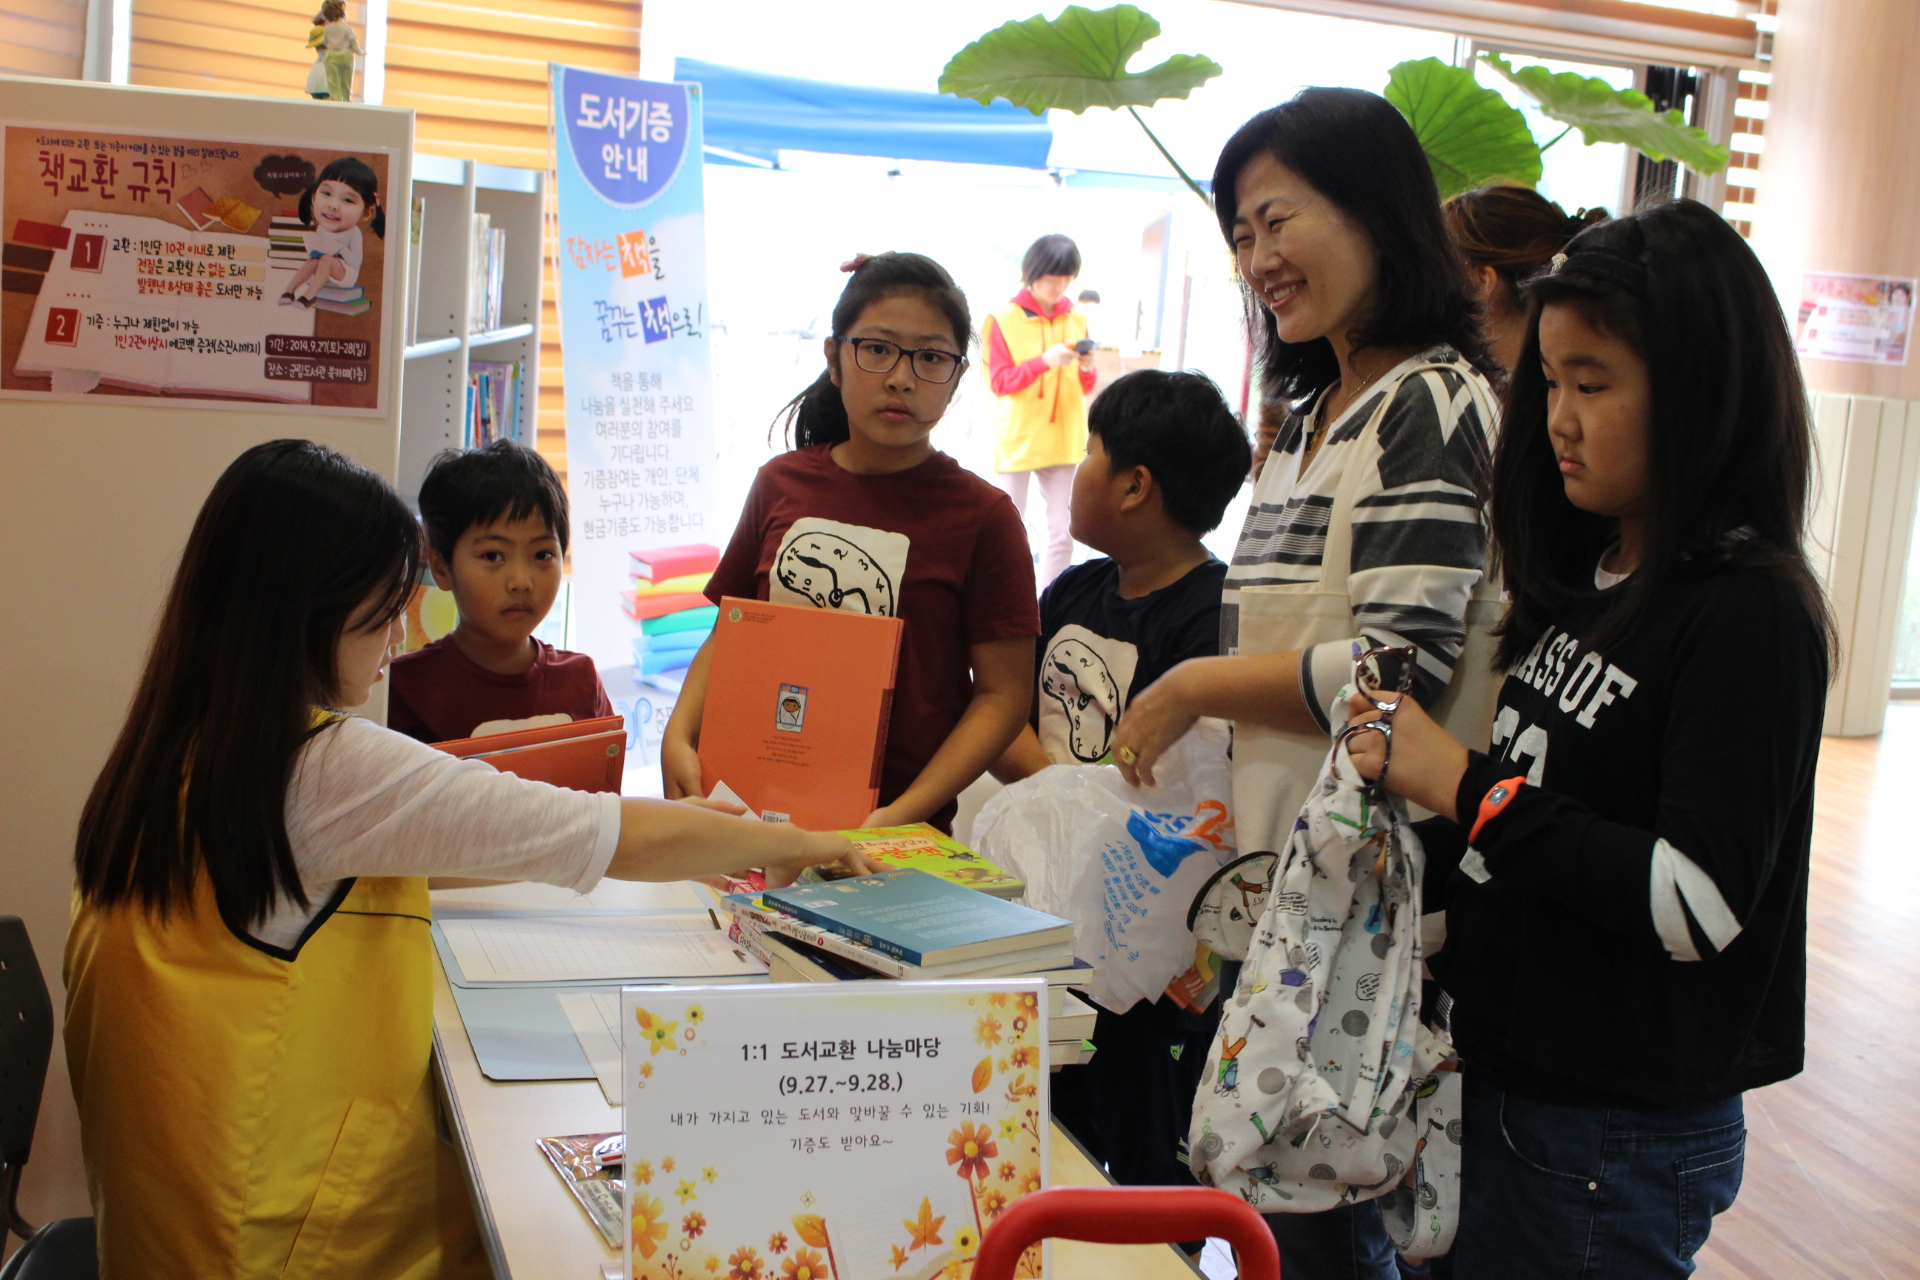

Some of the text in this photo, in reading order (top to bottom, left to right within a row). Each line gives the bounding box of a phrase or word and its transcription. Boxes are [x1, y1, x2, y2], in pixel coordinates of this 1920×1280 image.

[576, 92, 674, 144] 도서기증
[77, 140, 89, 150] 교환
[94, 141, 106, 150] 또는
[150, 145, 157, 154] 수
[158, 145, 170, 156] 있는
[602, 144, 648, 182] 안내
[38, 150, 175, 204] 책교환 규칙
[84, 242, 92, 264] 1
[112, 237, 131, 253] 교환
[140, 240, 162, 255] 1인당
[166, 242, 185, 256] 10권
[188, 244, 214, 256] 이내로
[218, 245, 235, 259] 제한
[167, 259, 193, 276] 교환할
[197, 261, 205, 276] 수
[208, 262, 225, 278] 없는
[229, 264, 246, 277] 도서
[138, 278, 165, 294] 발행년
[196, 281, 213, 297] 좋은
[216, 283, 242, 298] 도서만
[246, 286, 262, 300] 가능
[56, 315, 65, 335] 2
[87, 314, 104, 329] 기증
[113, 316, 140, 329] 누구나
[182, 321, 199, 334] 가능
[594, 297, 702, 342] 꿈꾸는 책으로!
[269, 339, 284, 351] 기간
[268, 363, 283, 376] 장소
[611, 372, 662, 392] 책을 통해
[581, 396, 615, 416] 나눔을
[620, 396, 655, 416] 실천해
[596, 419, 682, 440] 여러분의 참여를
[583, 470, 641, 490] 기증참여는
[676, 466, 699, 484] 단체
[599, 493, 633, 512] 누구나
[583, 517, 641, 539] 현금기증도
[833, 548, 848, 560] 2
[858, 559, 868, 571] 3
[875, 577, 885, 593] 4
[815, 592, 826, 607] 9
[1079, 657, 1094, 668] 2
[1099, 671, 1106, 683] 3
[1507, 624, 1638, 730] ASS OF
[1067, 697, 1075, 710] 9
[1107, 688, 1114, 703] 4
[1074, 715, 1081, 731] 8
[1075, 737, 1083, 753] 7
[1091, 744, 1098, 758] 6
[741, 1038, 941, 1061] 1:1 도서교환 나눔마당
[779, 1072, 903, 1096] (9.27.~9.28.)
[670, 1101, 991, 1127] 내가 가지고 있는 도서와 맞바꿀 수 있는 기회!
[790, 1134, 893, 1154] 기증도 받아요~
